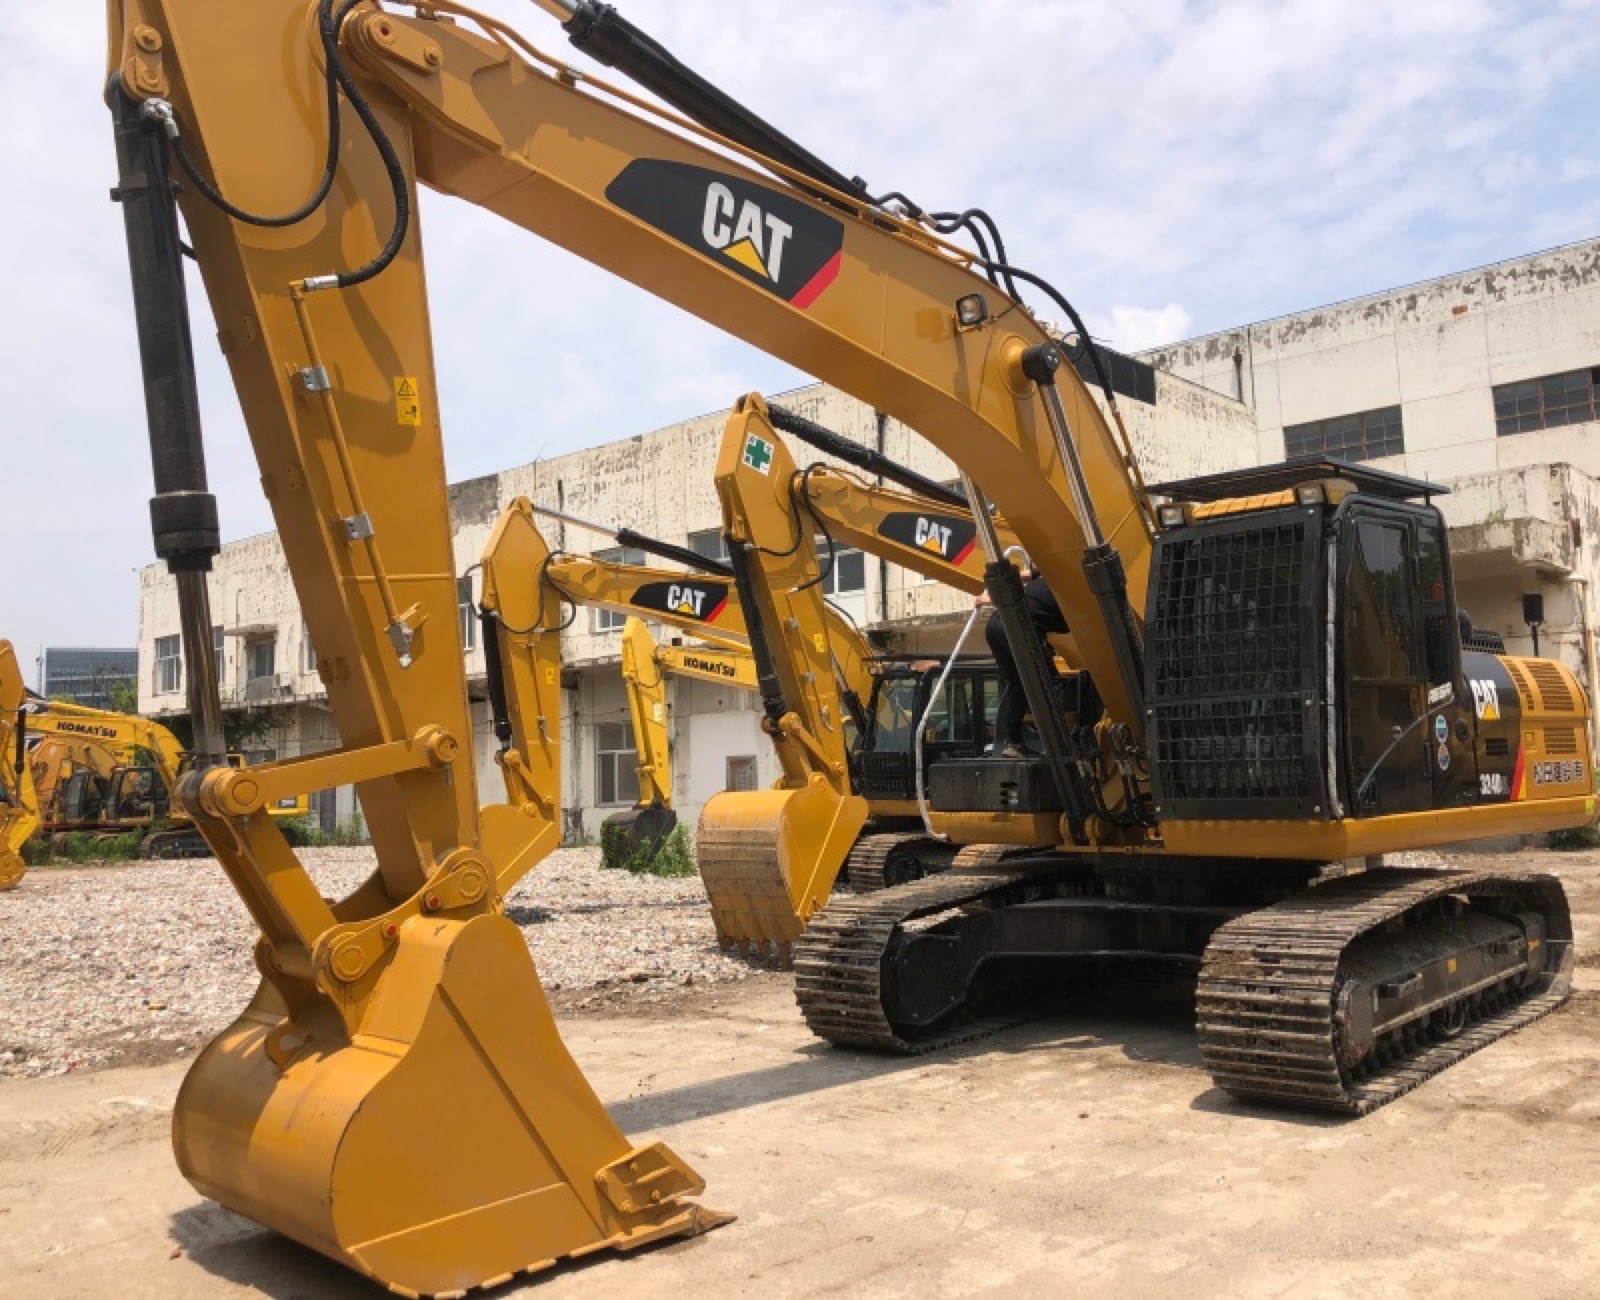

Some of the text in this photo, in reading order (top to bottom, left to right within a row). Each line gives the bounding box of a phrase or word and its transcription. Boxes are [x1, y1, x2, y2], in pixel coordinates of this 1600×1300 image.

[701, 181, 793, 284] CAT
[915, 517, 952, 556] CAT
[667, 585, 706, 616] CAT
[684, 656, 735, 677] KOMATSU
[1470, 679, 1500, 719] CAT
[57, 721, 117, 738] KOMATSU
